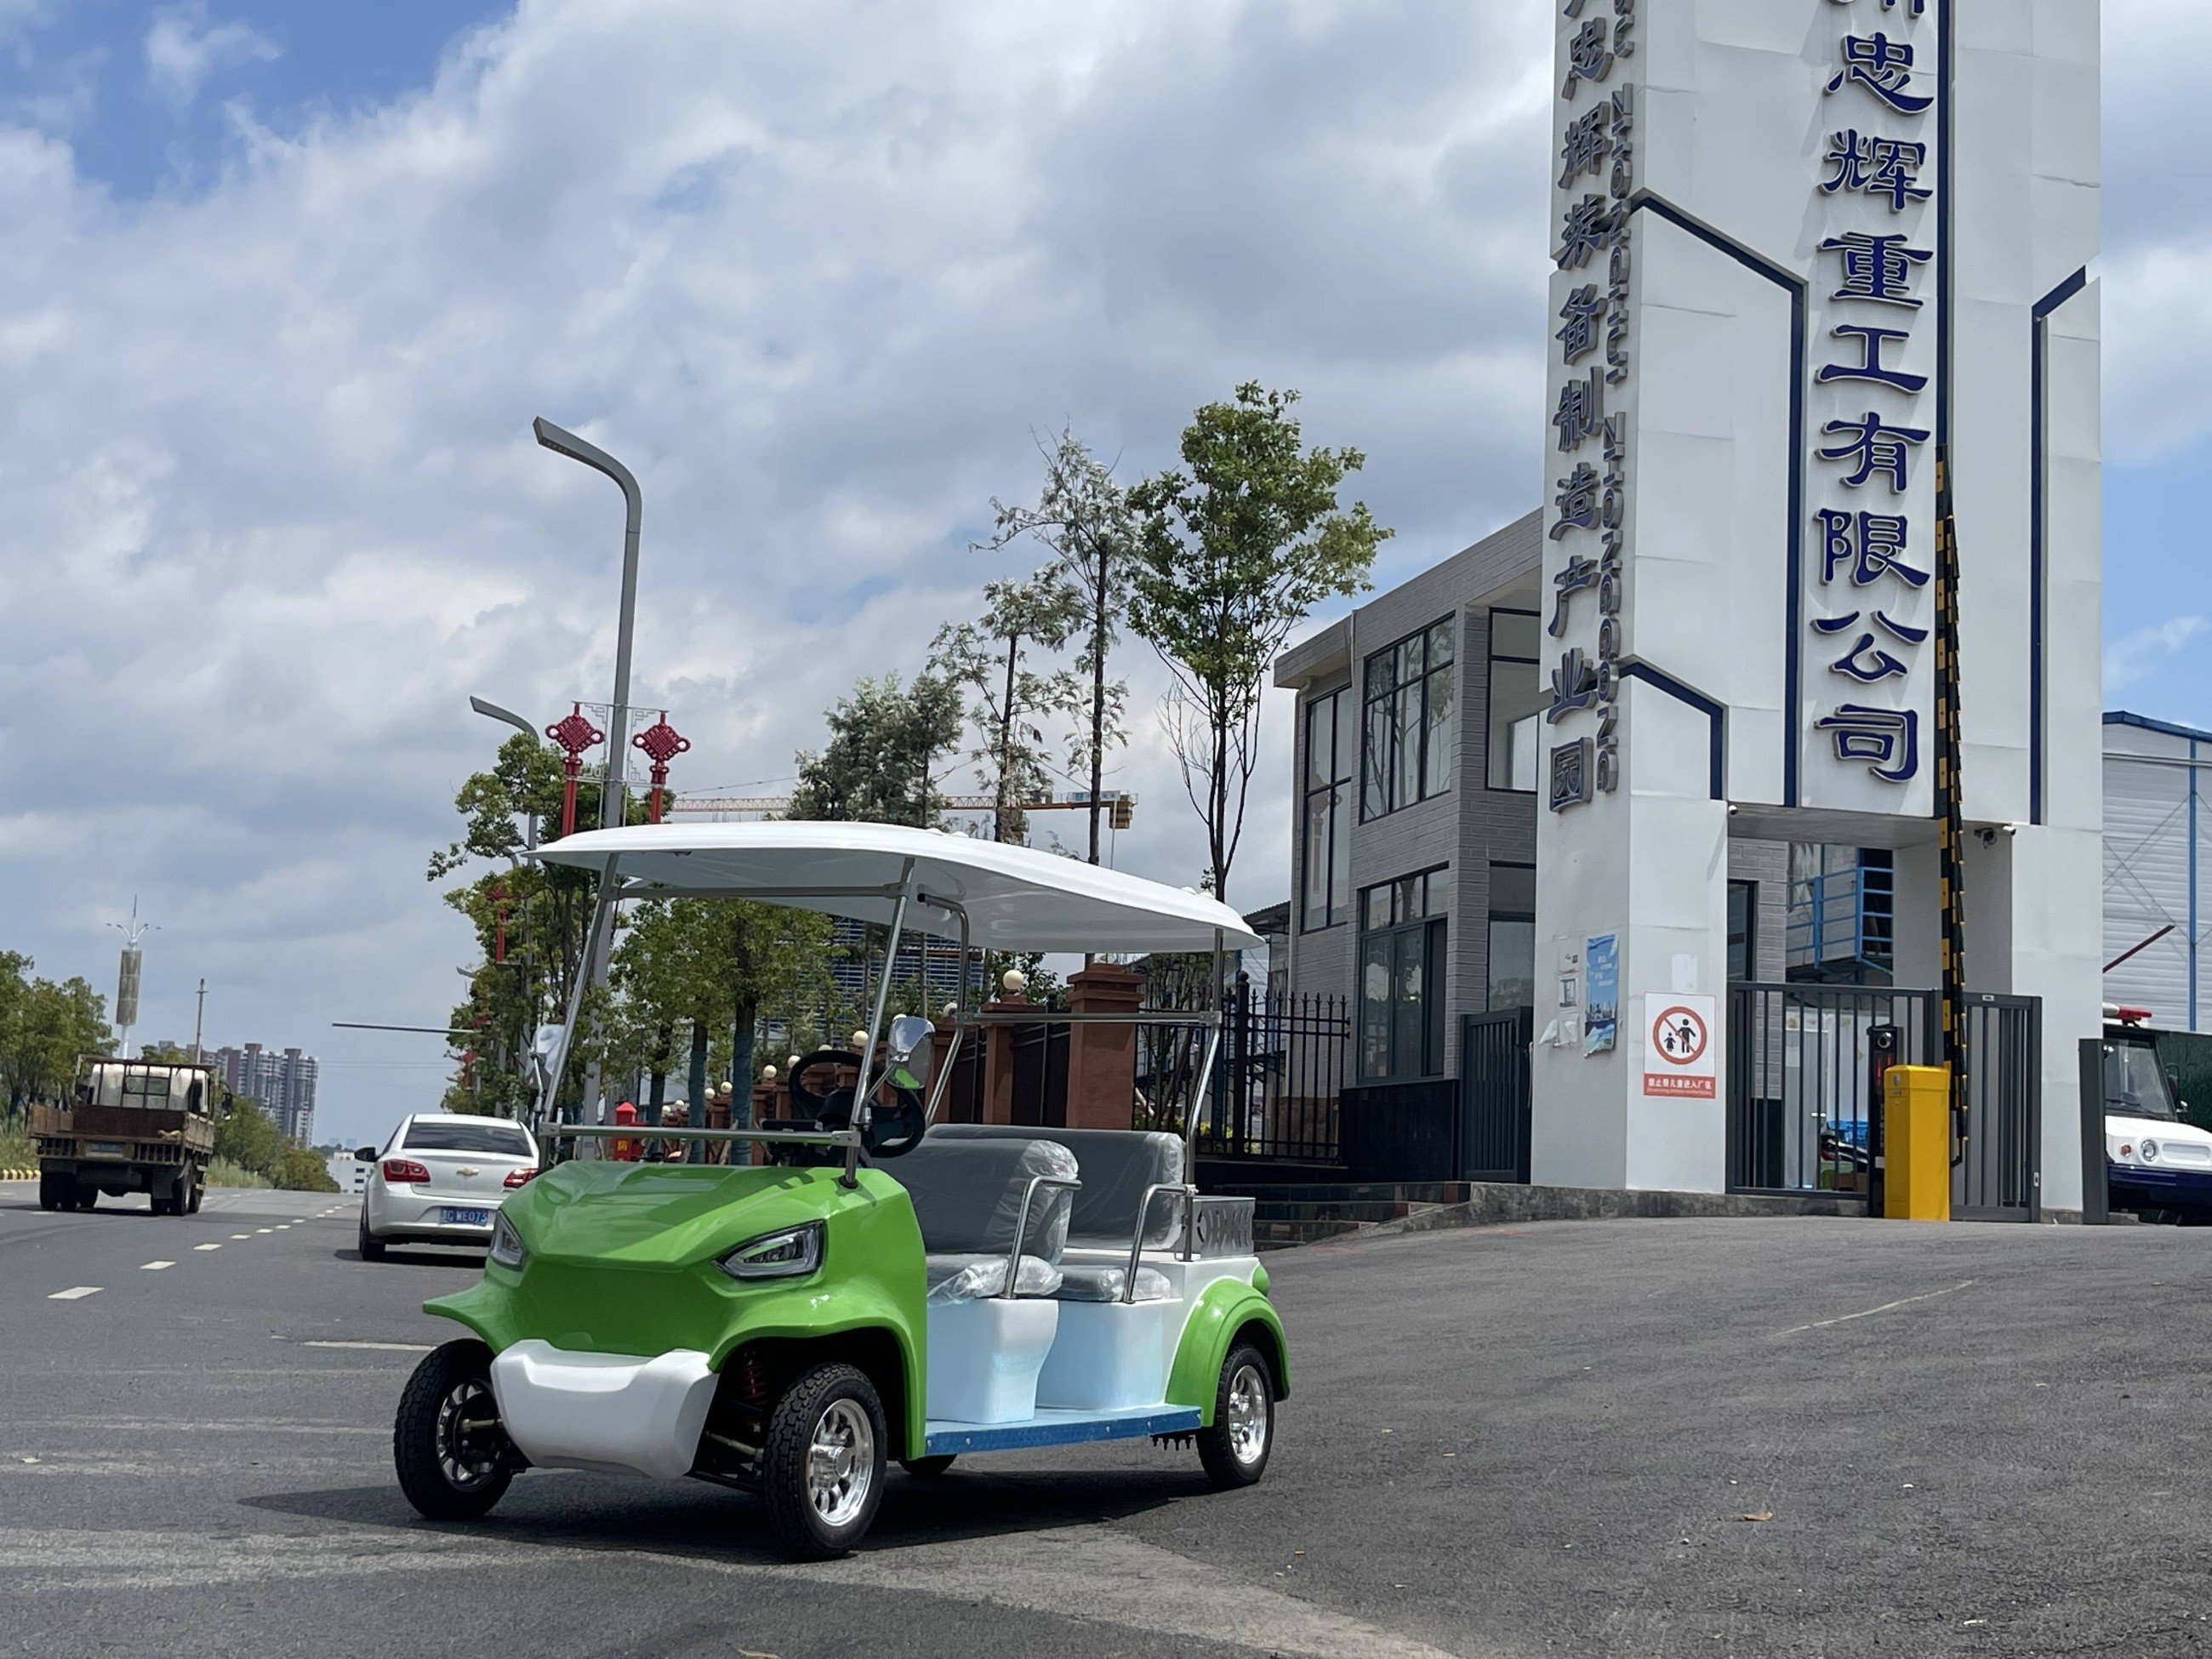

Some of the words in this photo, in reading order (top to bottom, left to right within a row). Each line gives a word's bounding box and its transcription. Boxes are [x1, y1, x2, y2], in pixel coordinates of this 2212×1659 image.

[1548, 0, 1614, 808] 忠辉装备制造产业园
[1810, 0, 1936, 783] 忠辉重工有限公司
